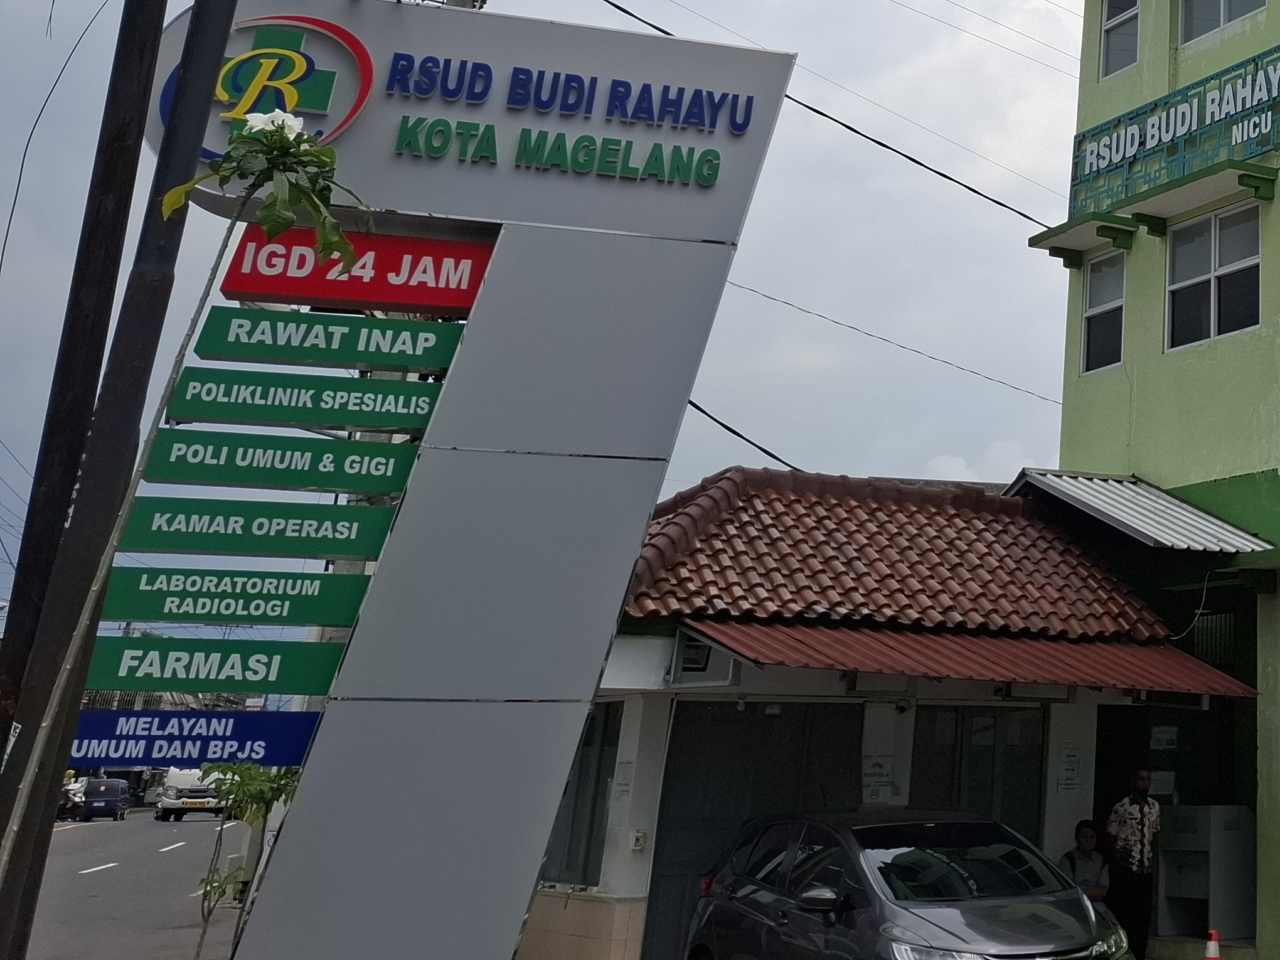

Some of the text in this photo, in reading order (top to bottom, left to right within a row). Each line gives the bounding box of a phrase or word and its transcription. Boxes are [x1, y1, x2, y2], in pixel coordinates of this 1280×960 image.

[386, 52, 755, 135] RSUD BUDI RAHAYU
[1084, 125, 1140, 175] RSUD
[1144, 98, 1199, 150] BUDI
[1231, 111, 1273, 146] NICU
[395, 114, 721, 187] KOTA MAGELANG
[240, 242, 316, 278] IGD
[387, 254, 473, 291] JAM
[227, 318, 437, 356] RAWAT INAP
[185, 381, 431, 416] POLIKLINIK SPESIALIS
[169, 442, 396, 477] POLI UMUM & GIGI
[151, 512, 359, 540] KAMAR OPERASI
[138, 573, 321, 597] LABORATORIUM
[163, 596, 291, 617] RADIOLOGI
[117, 649, 282, 683] FARMASI
[115, 716, 235, 737] MELAYANI
[70, 739, 266, 761] UMUM DAN BPJS
